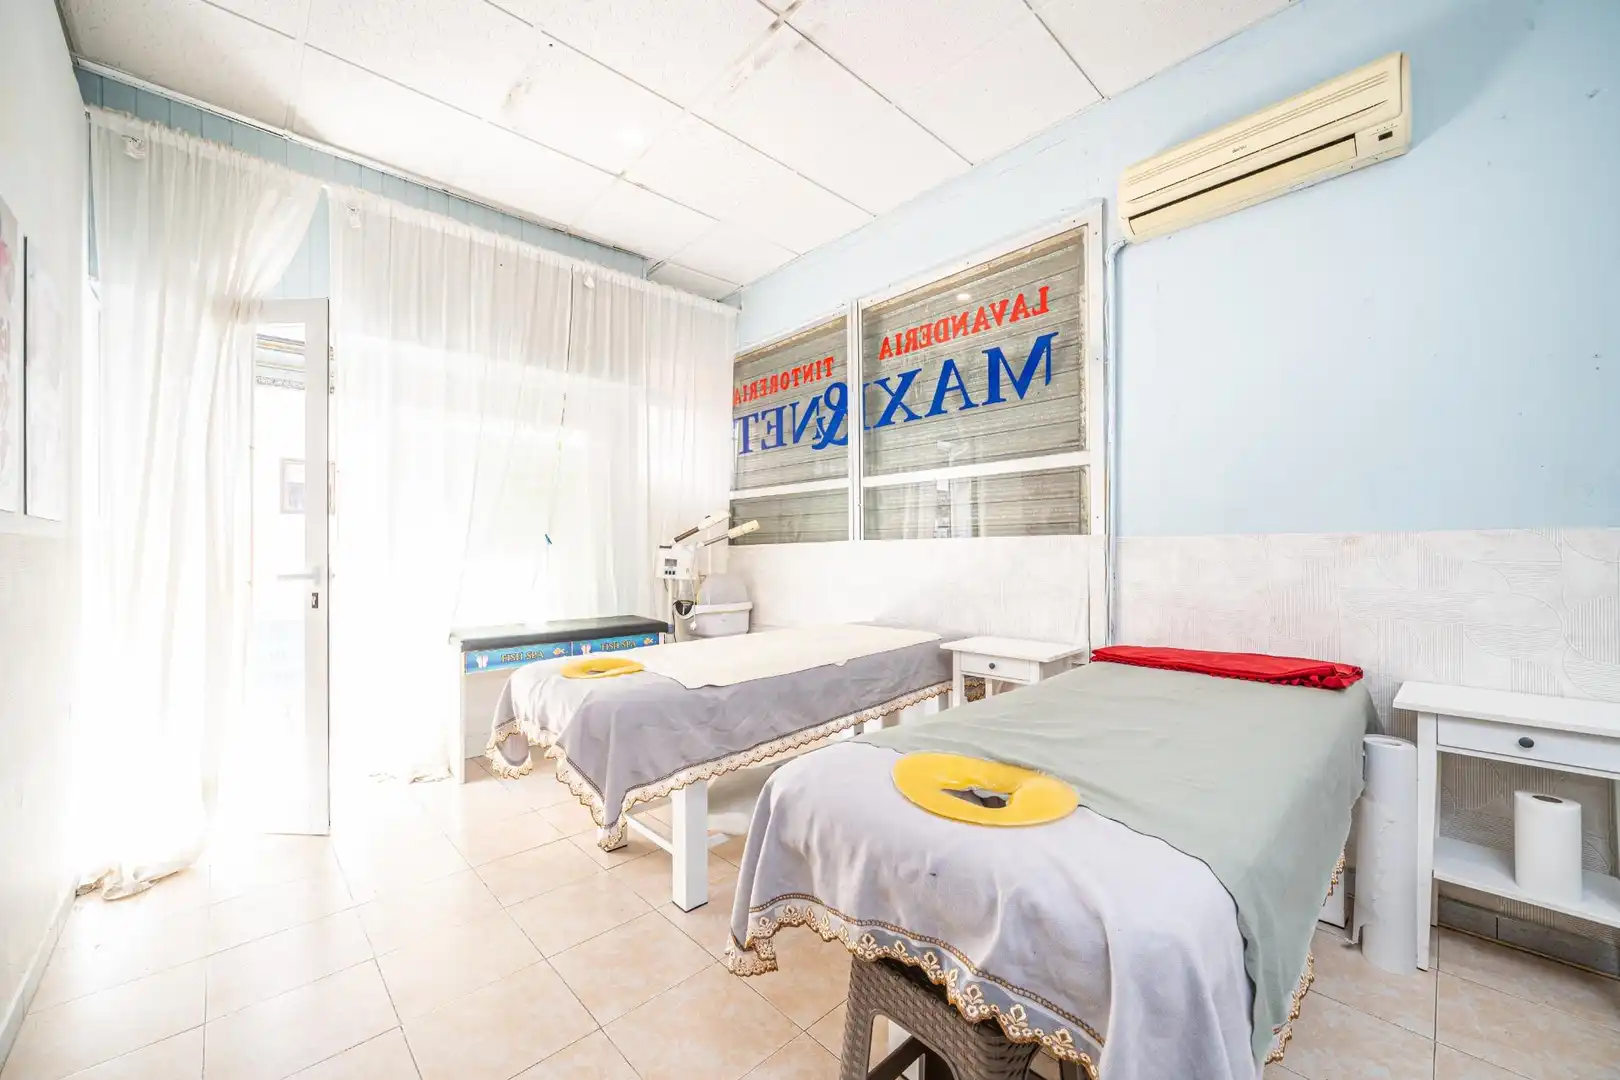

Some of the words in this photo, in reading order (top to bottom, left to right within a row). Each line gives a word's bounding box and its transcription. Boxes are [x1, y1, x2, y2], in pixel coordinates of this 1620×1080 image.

[601, 641, 619, 651] FISH
[620, 640, 636, 649] SPA
[501, 651, 523, 663] FISH
[526, 650, 544, 661] SPA
